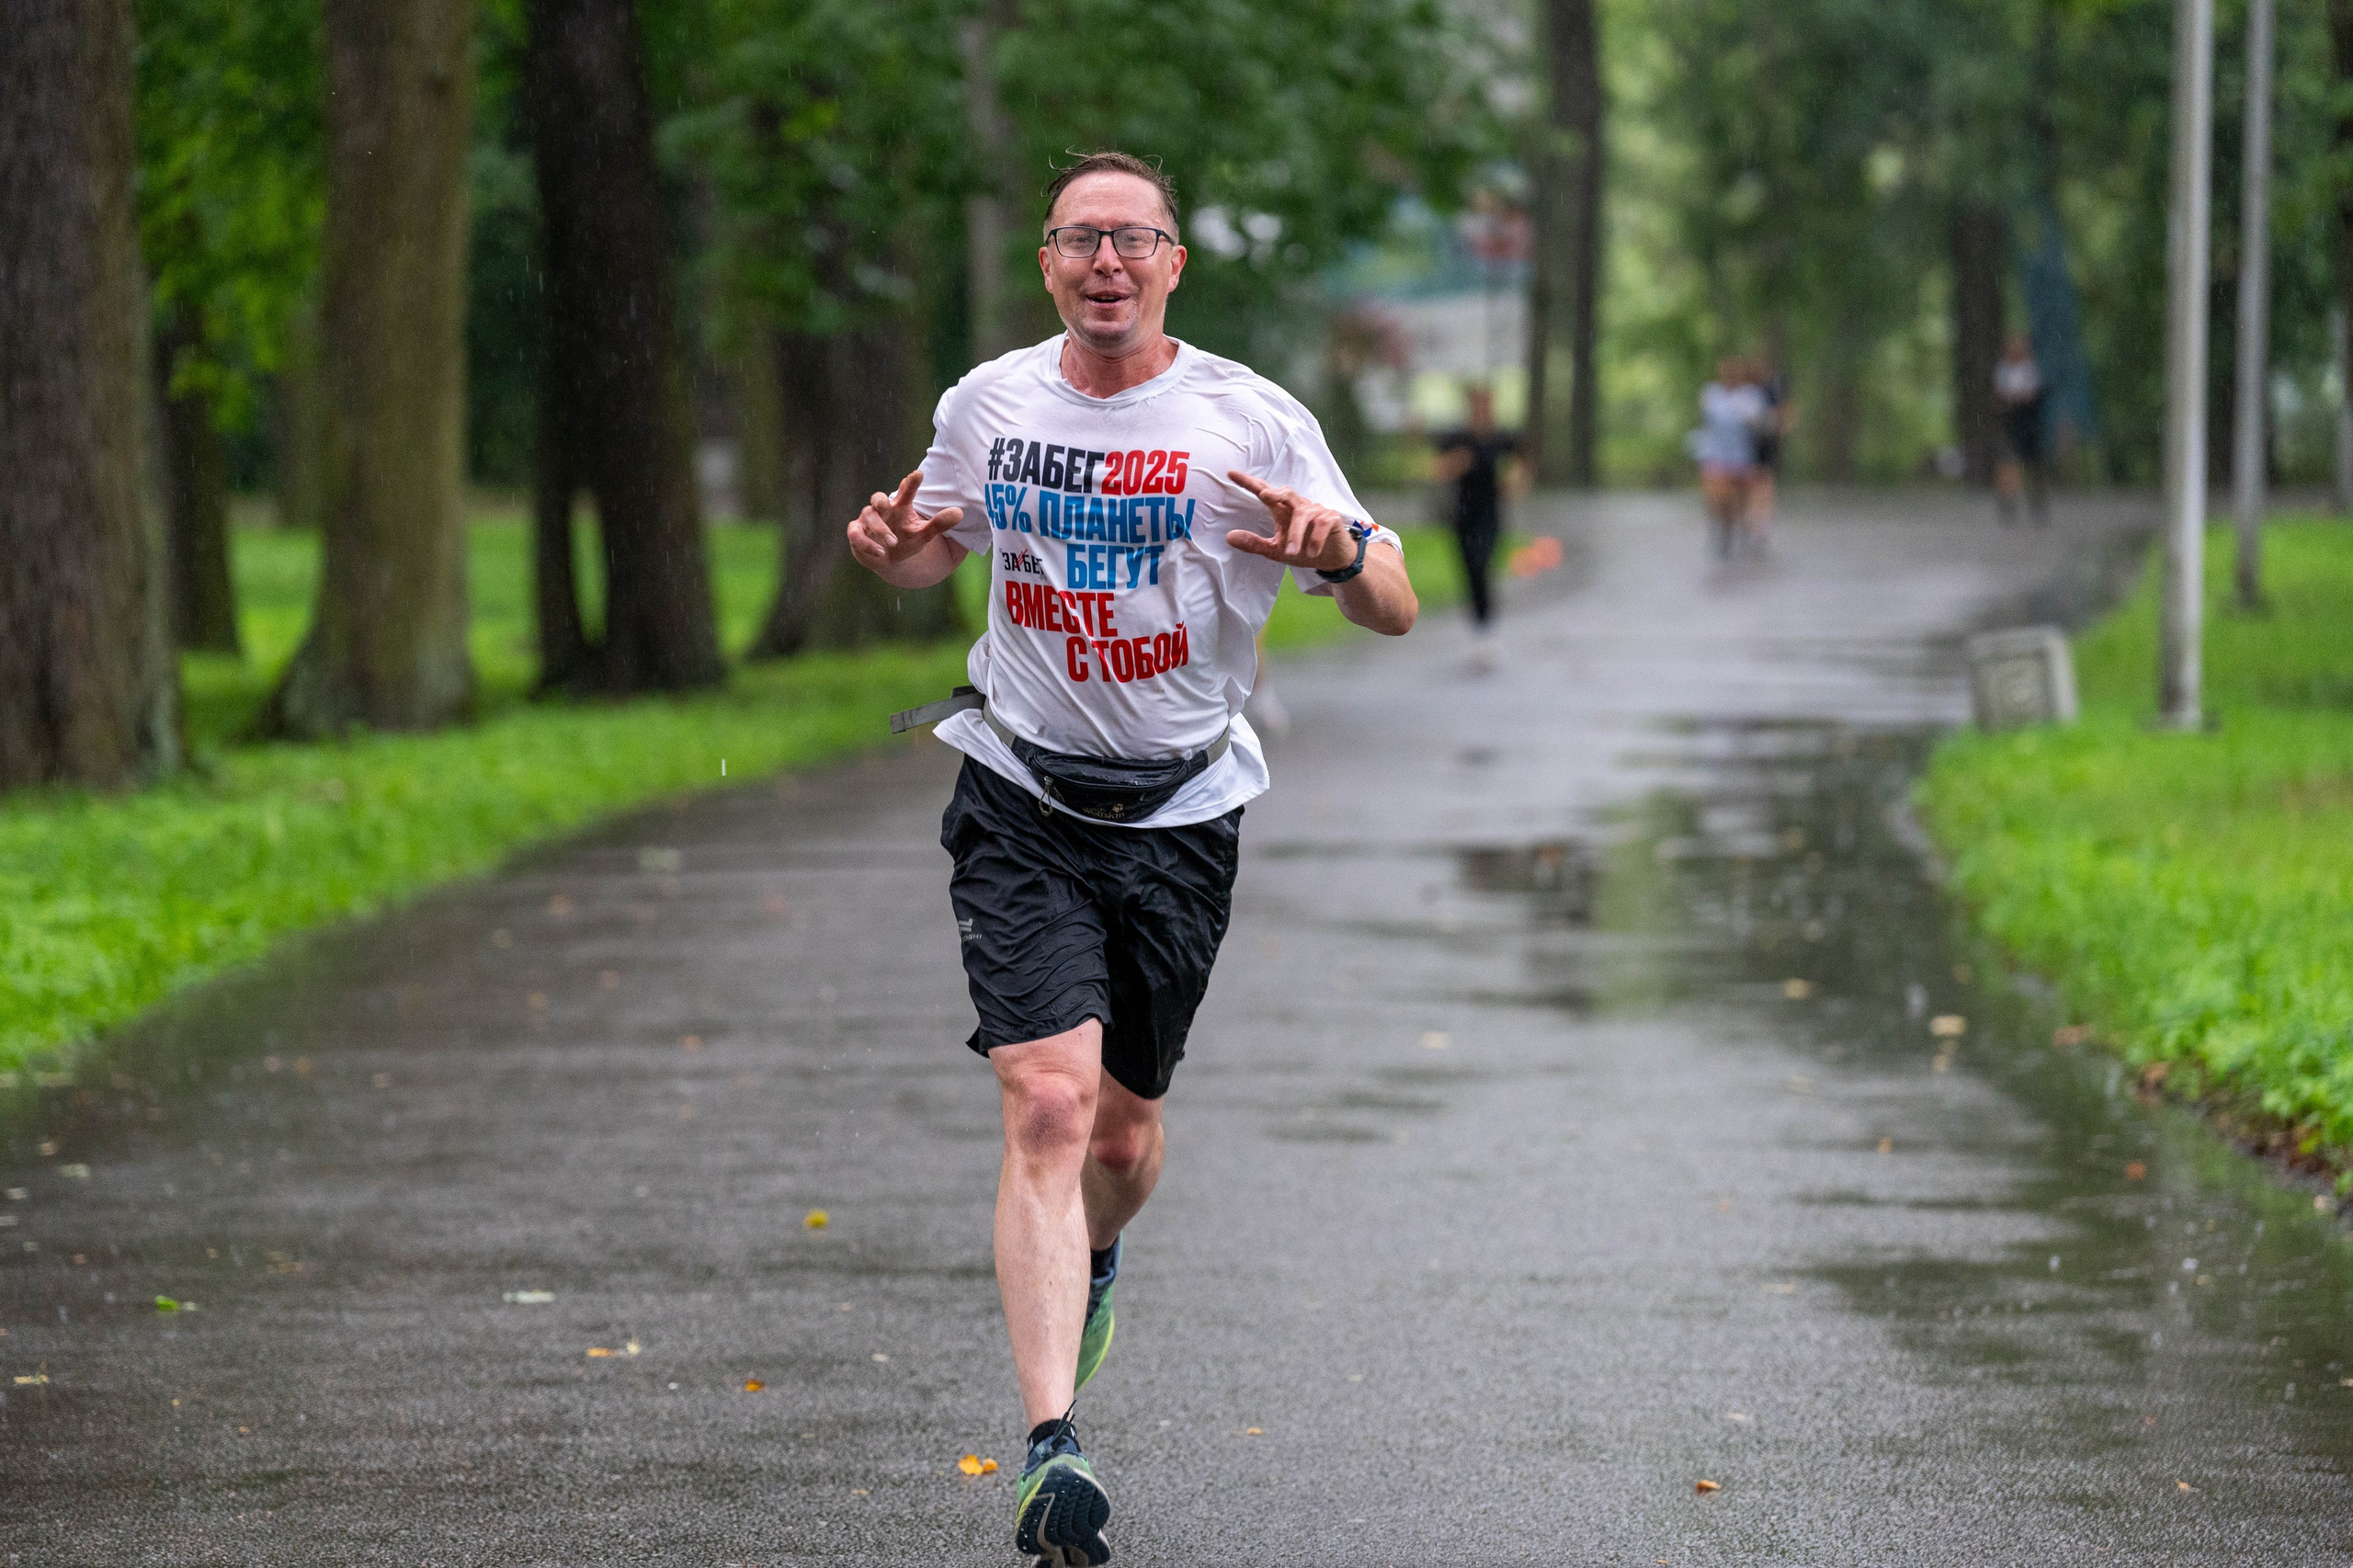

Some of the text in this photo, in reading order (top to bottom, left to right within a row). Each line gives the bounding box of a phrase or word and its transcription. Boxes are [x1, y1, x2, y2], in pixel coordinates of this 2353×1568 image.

[988, 437, 1189, 495] #ЗАБЕГ2025
[984, 483, 1196, 543] 45% ПЛАНЕТЫ
[1067, 544, 1165, 590] БЕГУТ
[1005, 580, 1119, 638] ВМЕСТЕ
[1066, 620, 1189, 684] С ТОБОЙ
